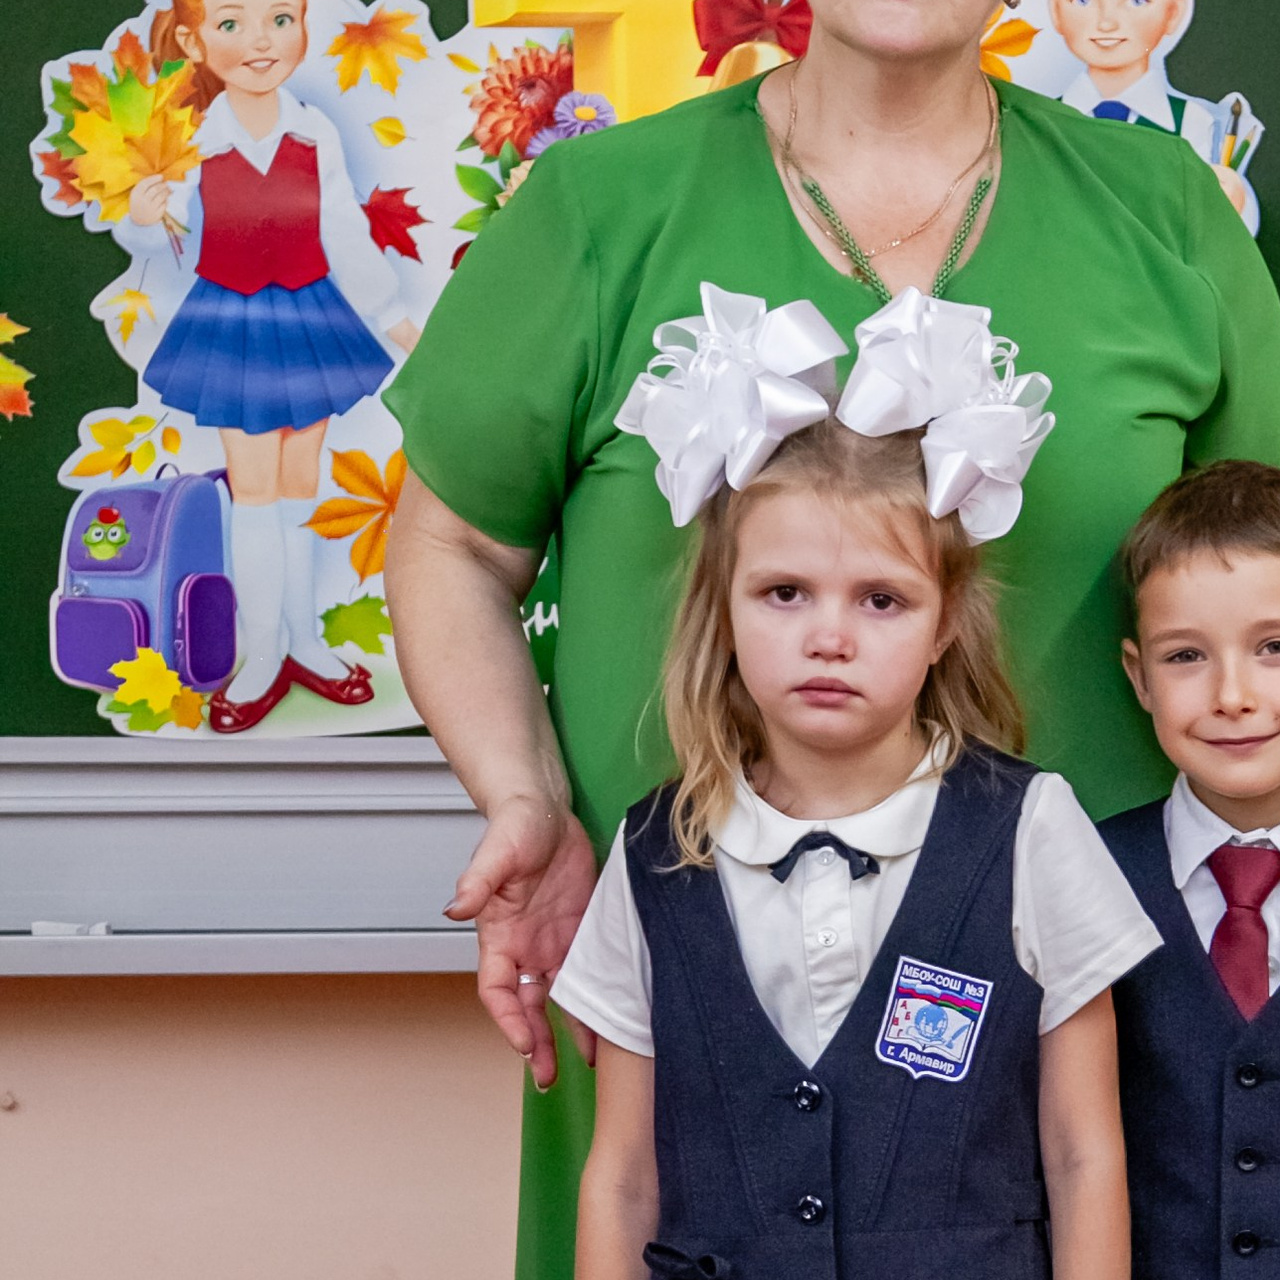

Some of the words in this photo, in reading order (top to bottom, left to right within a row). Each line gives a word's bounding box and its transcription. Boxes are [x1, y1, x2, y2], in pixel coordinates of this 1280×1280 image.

[901, 964, 962, 991] МБОУ-СОШ
[964, 982, 985, 997] №3
[898, 1046, 956, 1074] Армавир
